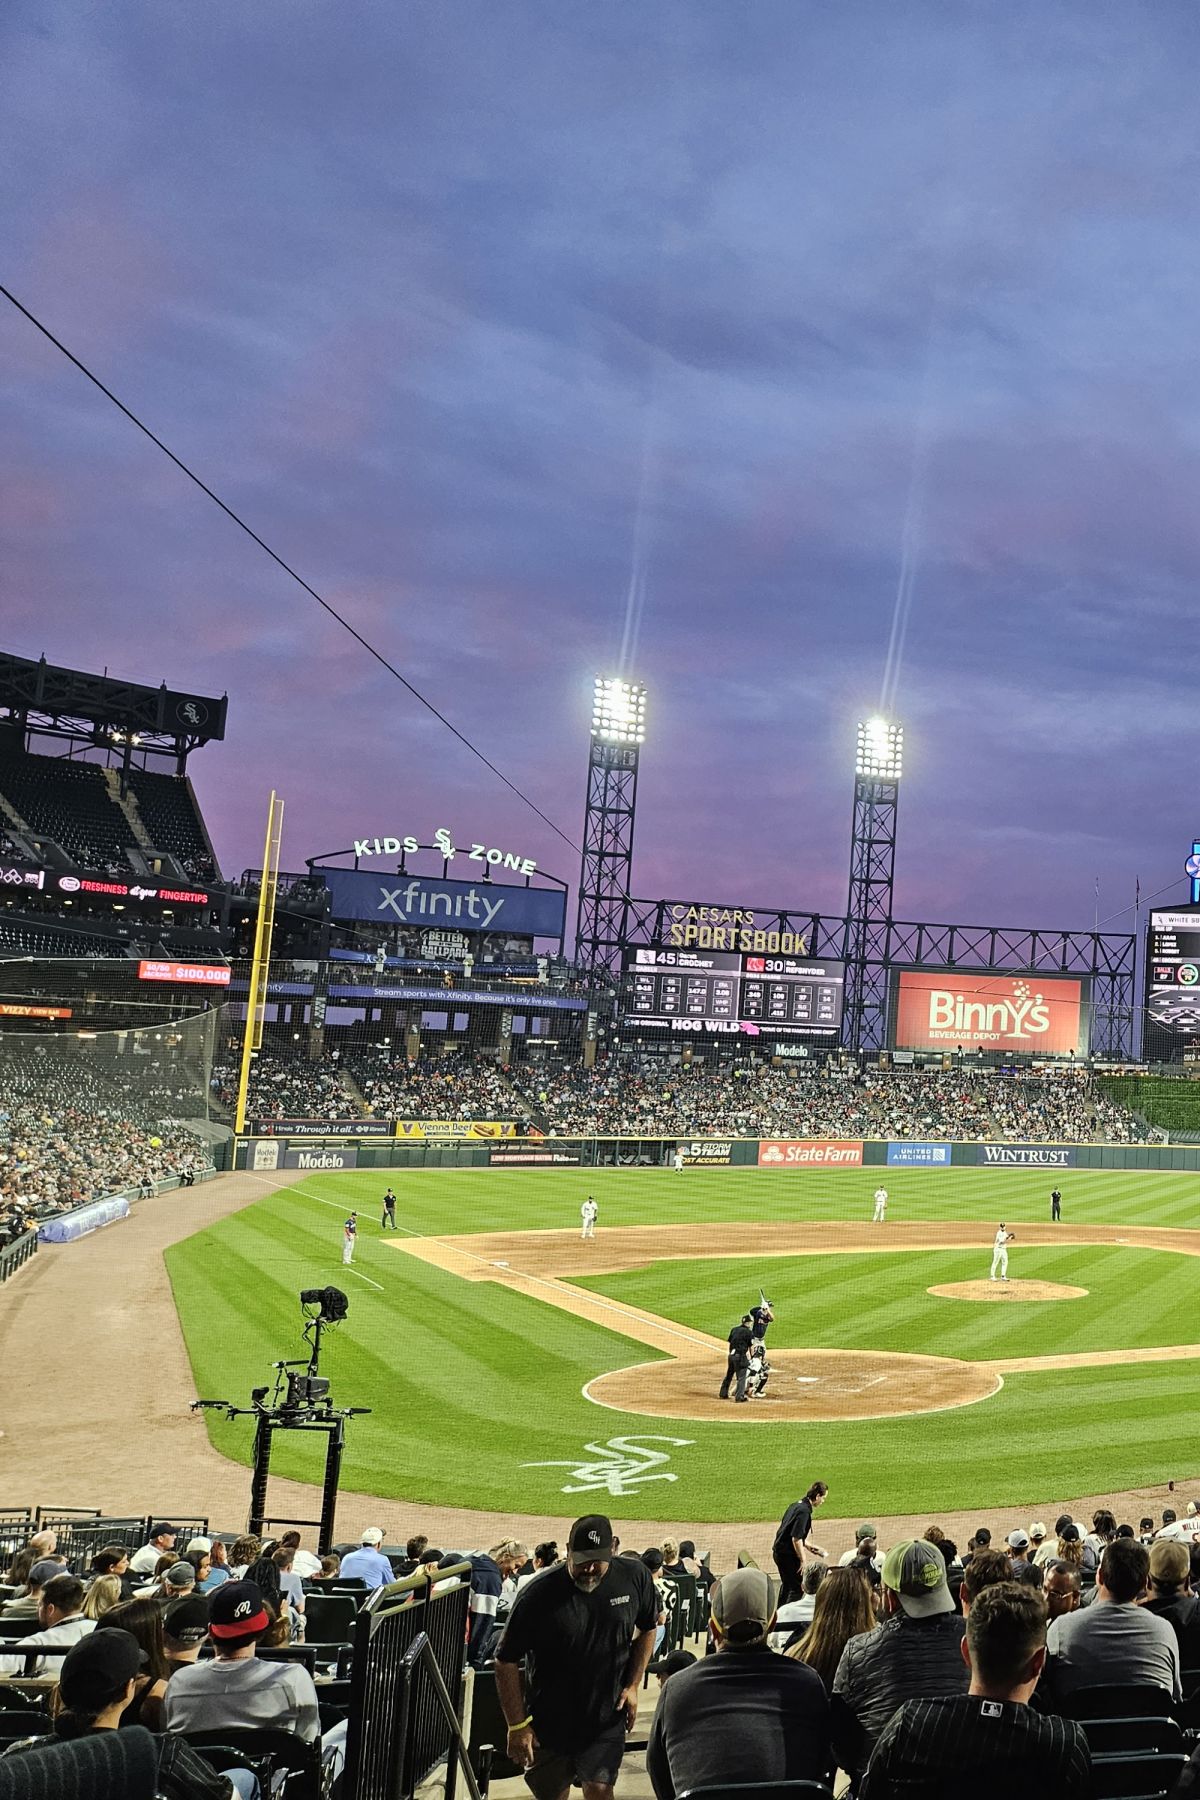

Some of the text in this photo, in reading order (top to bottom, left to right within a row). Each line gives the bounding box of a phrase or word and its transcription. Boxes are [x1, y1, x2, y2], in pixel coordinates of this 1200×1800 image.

[353, 836, 419, 857] KIDS
[468, 843, 537, 877] ZONE
[80, 880, 128, 895] FRESHNESS
[159, 889, 208, 904] FINGERTIPS
[377, 881, 505, 927] xfinity
[672, 904, 754, 925] CAESARS
[428, 930, 464, 942] BETTER
[671, 923, 809, 956] SPORTSBOOK
[421, 943, 468, 958] BALLPARK
[656, 952, 676, 965] 45
[679, 959, 714, 968] CROCHET
[765, 959, 783, 972] 30
[785, 966, 826, 975] REFSNYDER
[374, 988, 402, 997] Stream
[403, 990, 427, 999] sports
[428, 991, 445, 999] with
[446, 992, 473, 1001] Xfinity.
[474, 993, 504, 1002] Because
[505, 995, 515, 1003] it's
[516, 997, 530, 1005] only
[2, 1005, 32, 1015] VIZZY
[929, 991, 1050, 1038] Binny's
[671, 1020, 702, 1031] HOG
[704, 1021, 740, 1032] WILD
[929, 1030, 1000, 1040] BEVERAGE DEPOT
[775, 1044, 808, 1057] Modelo
[295, 1125, 331, 1135] Through
[333, 1125, 339, 1133] it
[418, 1122, 450, 1131] Vienna
[451, 1122, 473, 1131] Beef
[690, 1143, 701, 1156] 5
[701, 1148, 730, 1156] TEAM
[984, 1146, 1069, 1163] WINTRUST
[298, 1153, 344, 1169] Modelo
